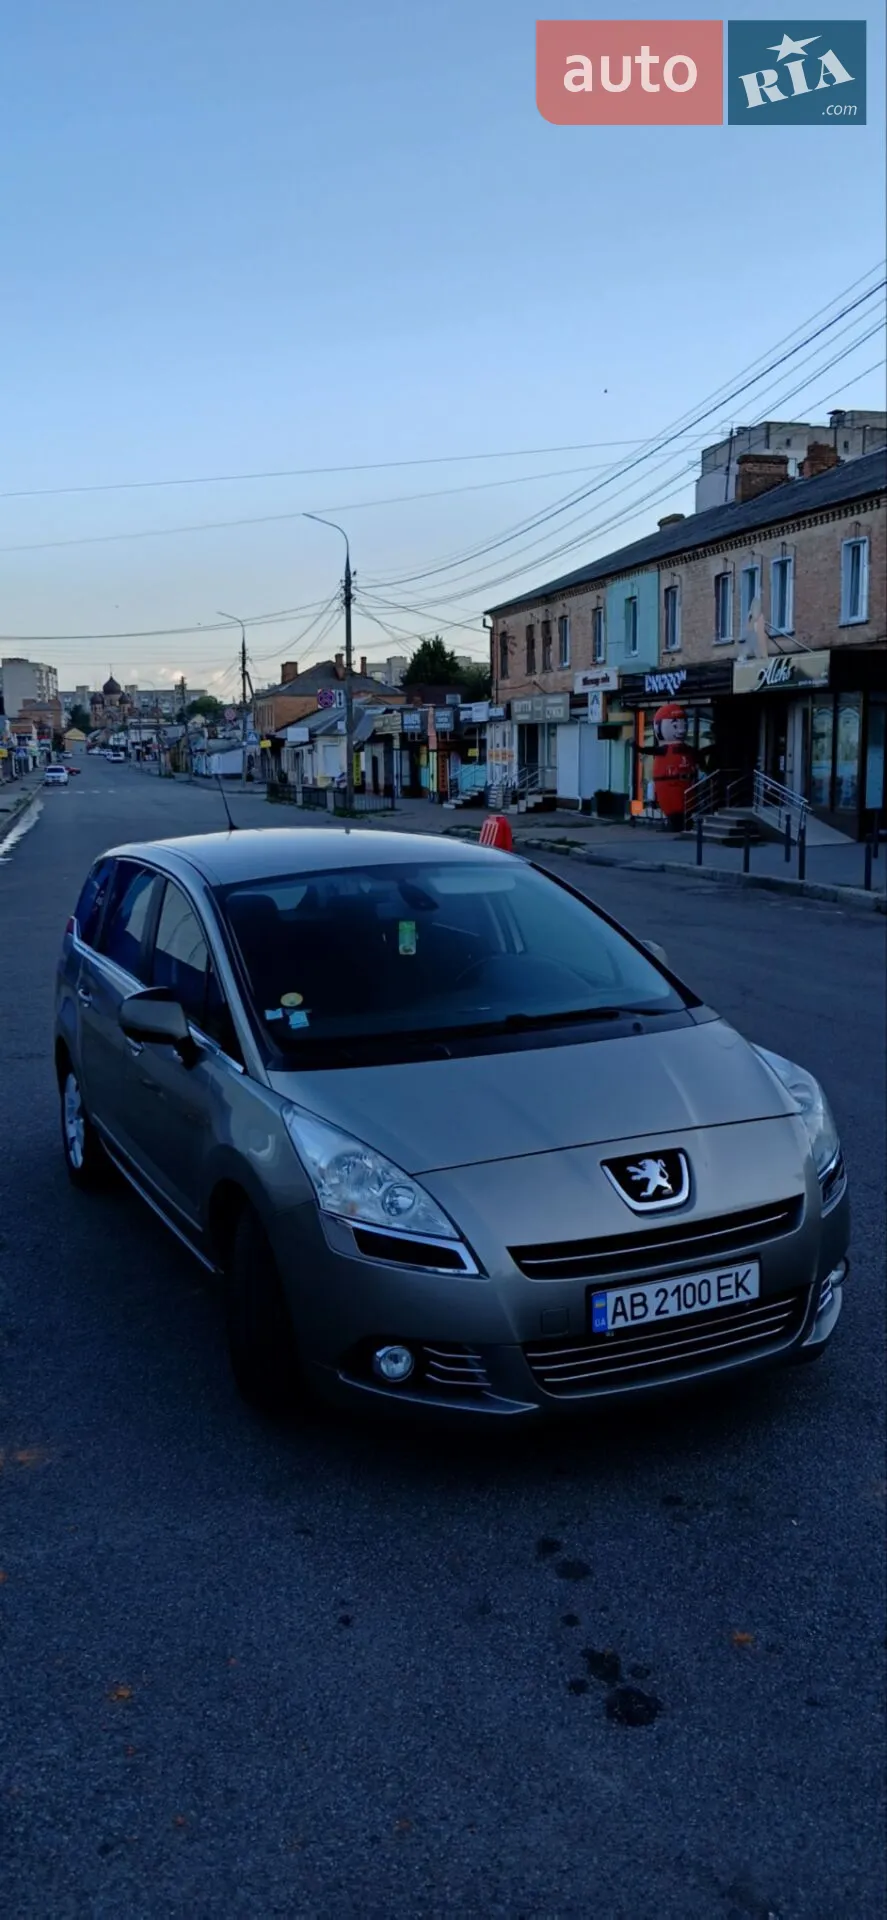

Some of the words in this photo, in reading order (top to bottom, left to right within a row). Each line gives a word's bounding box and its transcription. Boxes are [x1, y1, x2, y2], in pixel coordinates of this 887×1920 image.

[611, 1292, 649, 1325] AB
[655, 1279, 712, 1316] 2100
[717, 1269, 752, 1302] EK
[594, 1318, 606, 1328] UA
